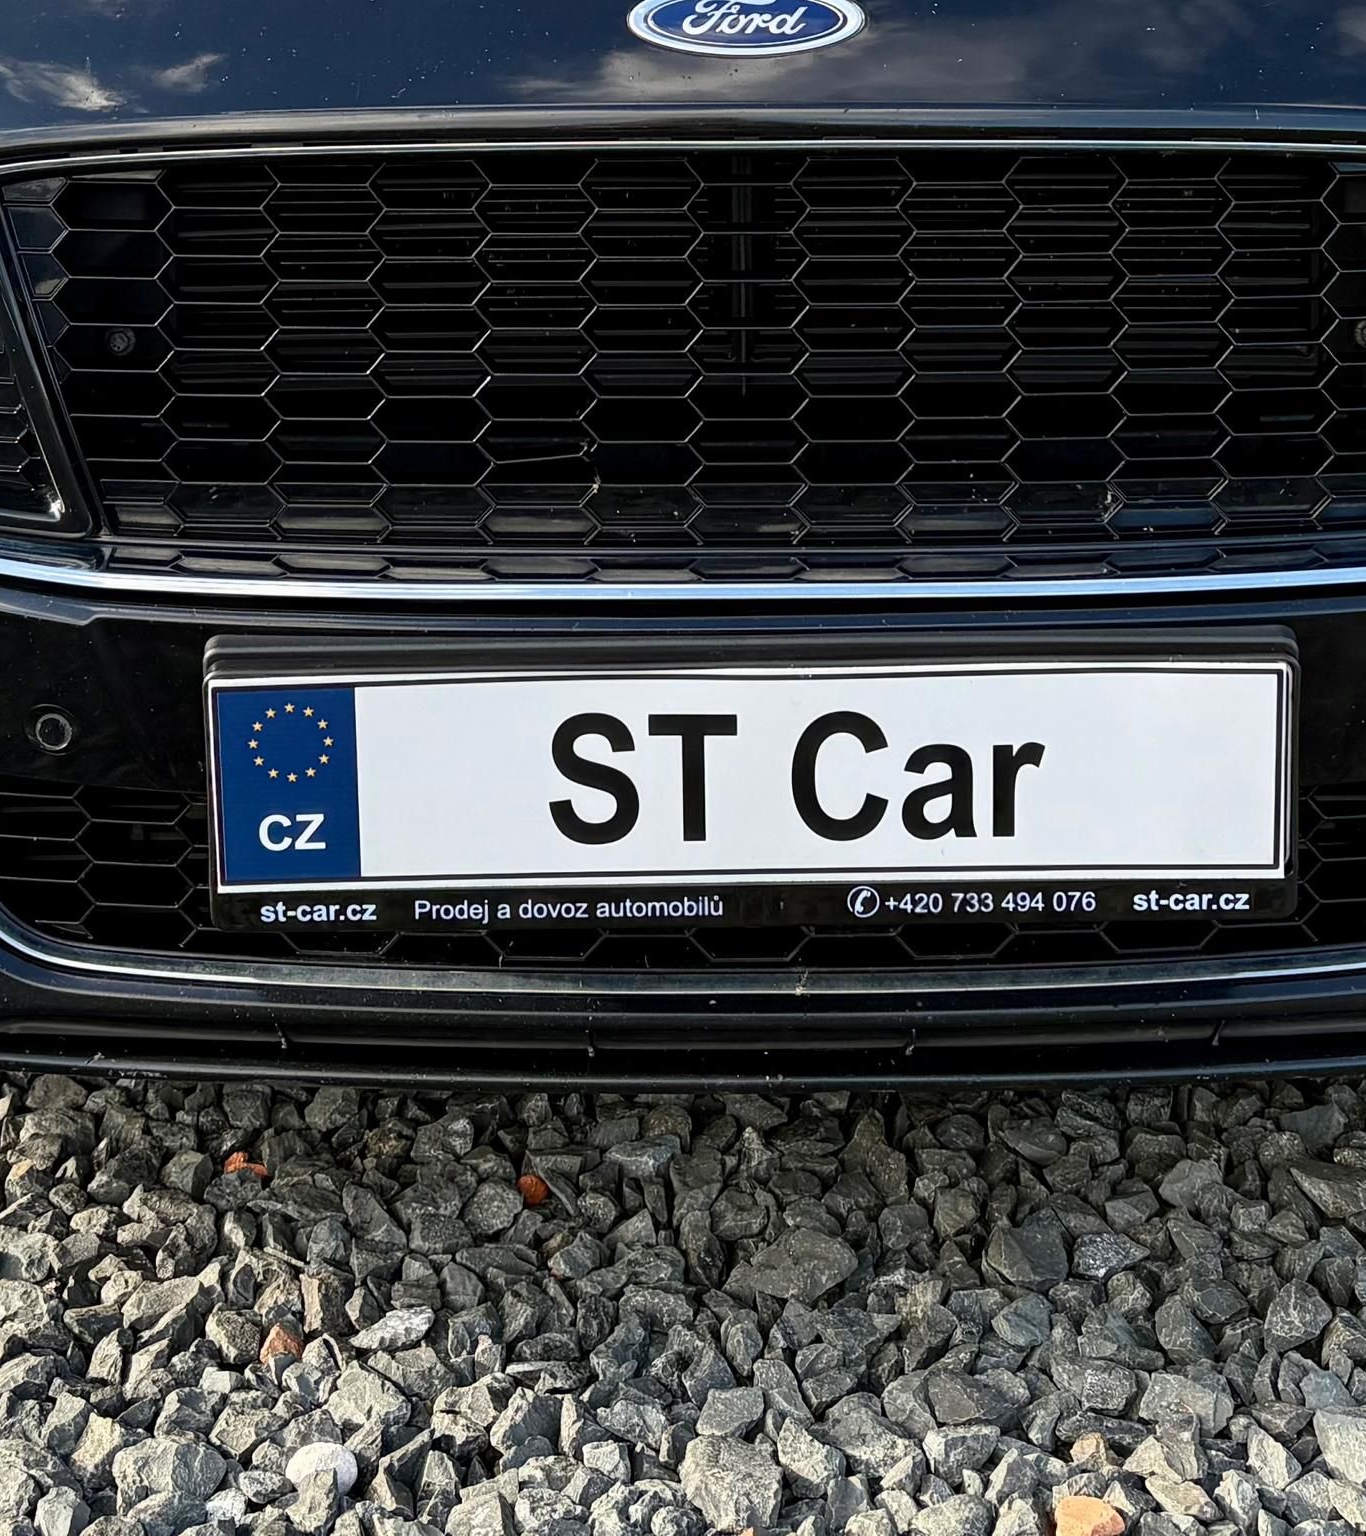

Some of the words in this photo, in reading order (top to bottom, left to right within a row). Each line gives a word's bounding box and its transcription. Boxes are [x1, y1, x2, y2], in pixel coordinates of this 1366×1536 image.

[549, 713, 737, 844] ST
[792, 711, 1045, 841] Car
[259, 814, 325, 851] CZ
[260, 901, 377, 923] st-car.cz
[414, 899, 489, 924] Prodej
[497, 903, 511, 919] a
[518, 898, 589, 919] dovoz
[596, 895, 723, 918] automobilů
[884, 892, 943, 914] +420
[951, 892, 994, 913] 733
[1000, 891, 1045, 912] 494
[1052, 891, 1096, 912] 076
[1133, 889, 1250, 911] st-car.cz
